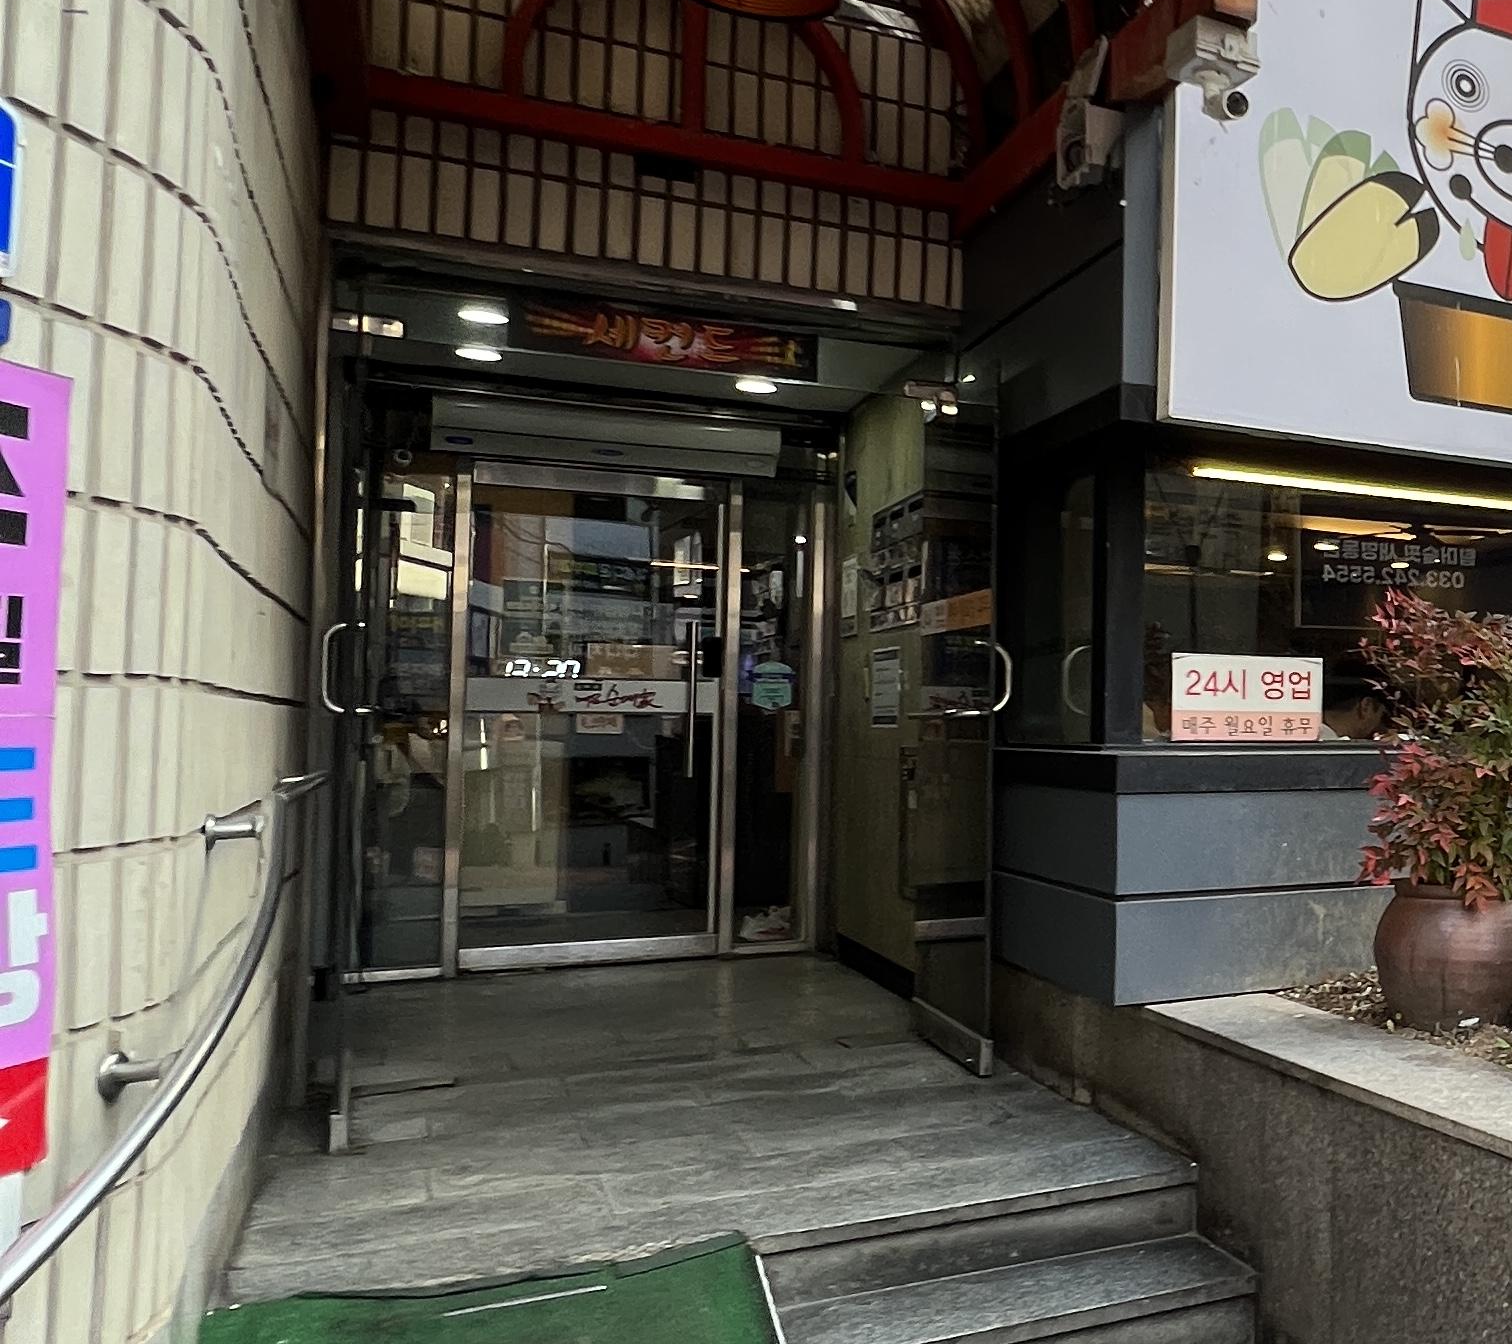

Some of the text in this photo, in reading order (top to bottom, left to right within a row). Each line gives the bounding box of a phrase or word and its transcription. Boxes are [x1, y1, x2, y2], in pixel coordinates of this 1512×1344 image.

[1184, 669, 1311, 700] 24시 영업
[1182, 715, 1313, 737] 매주 월요일 휴무
